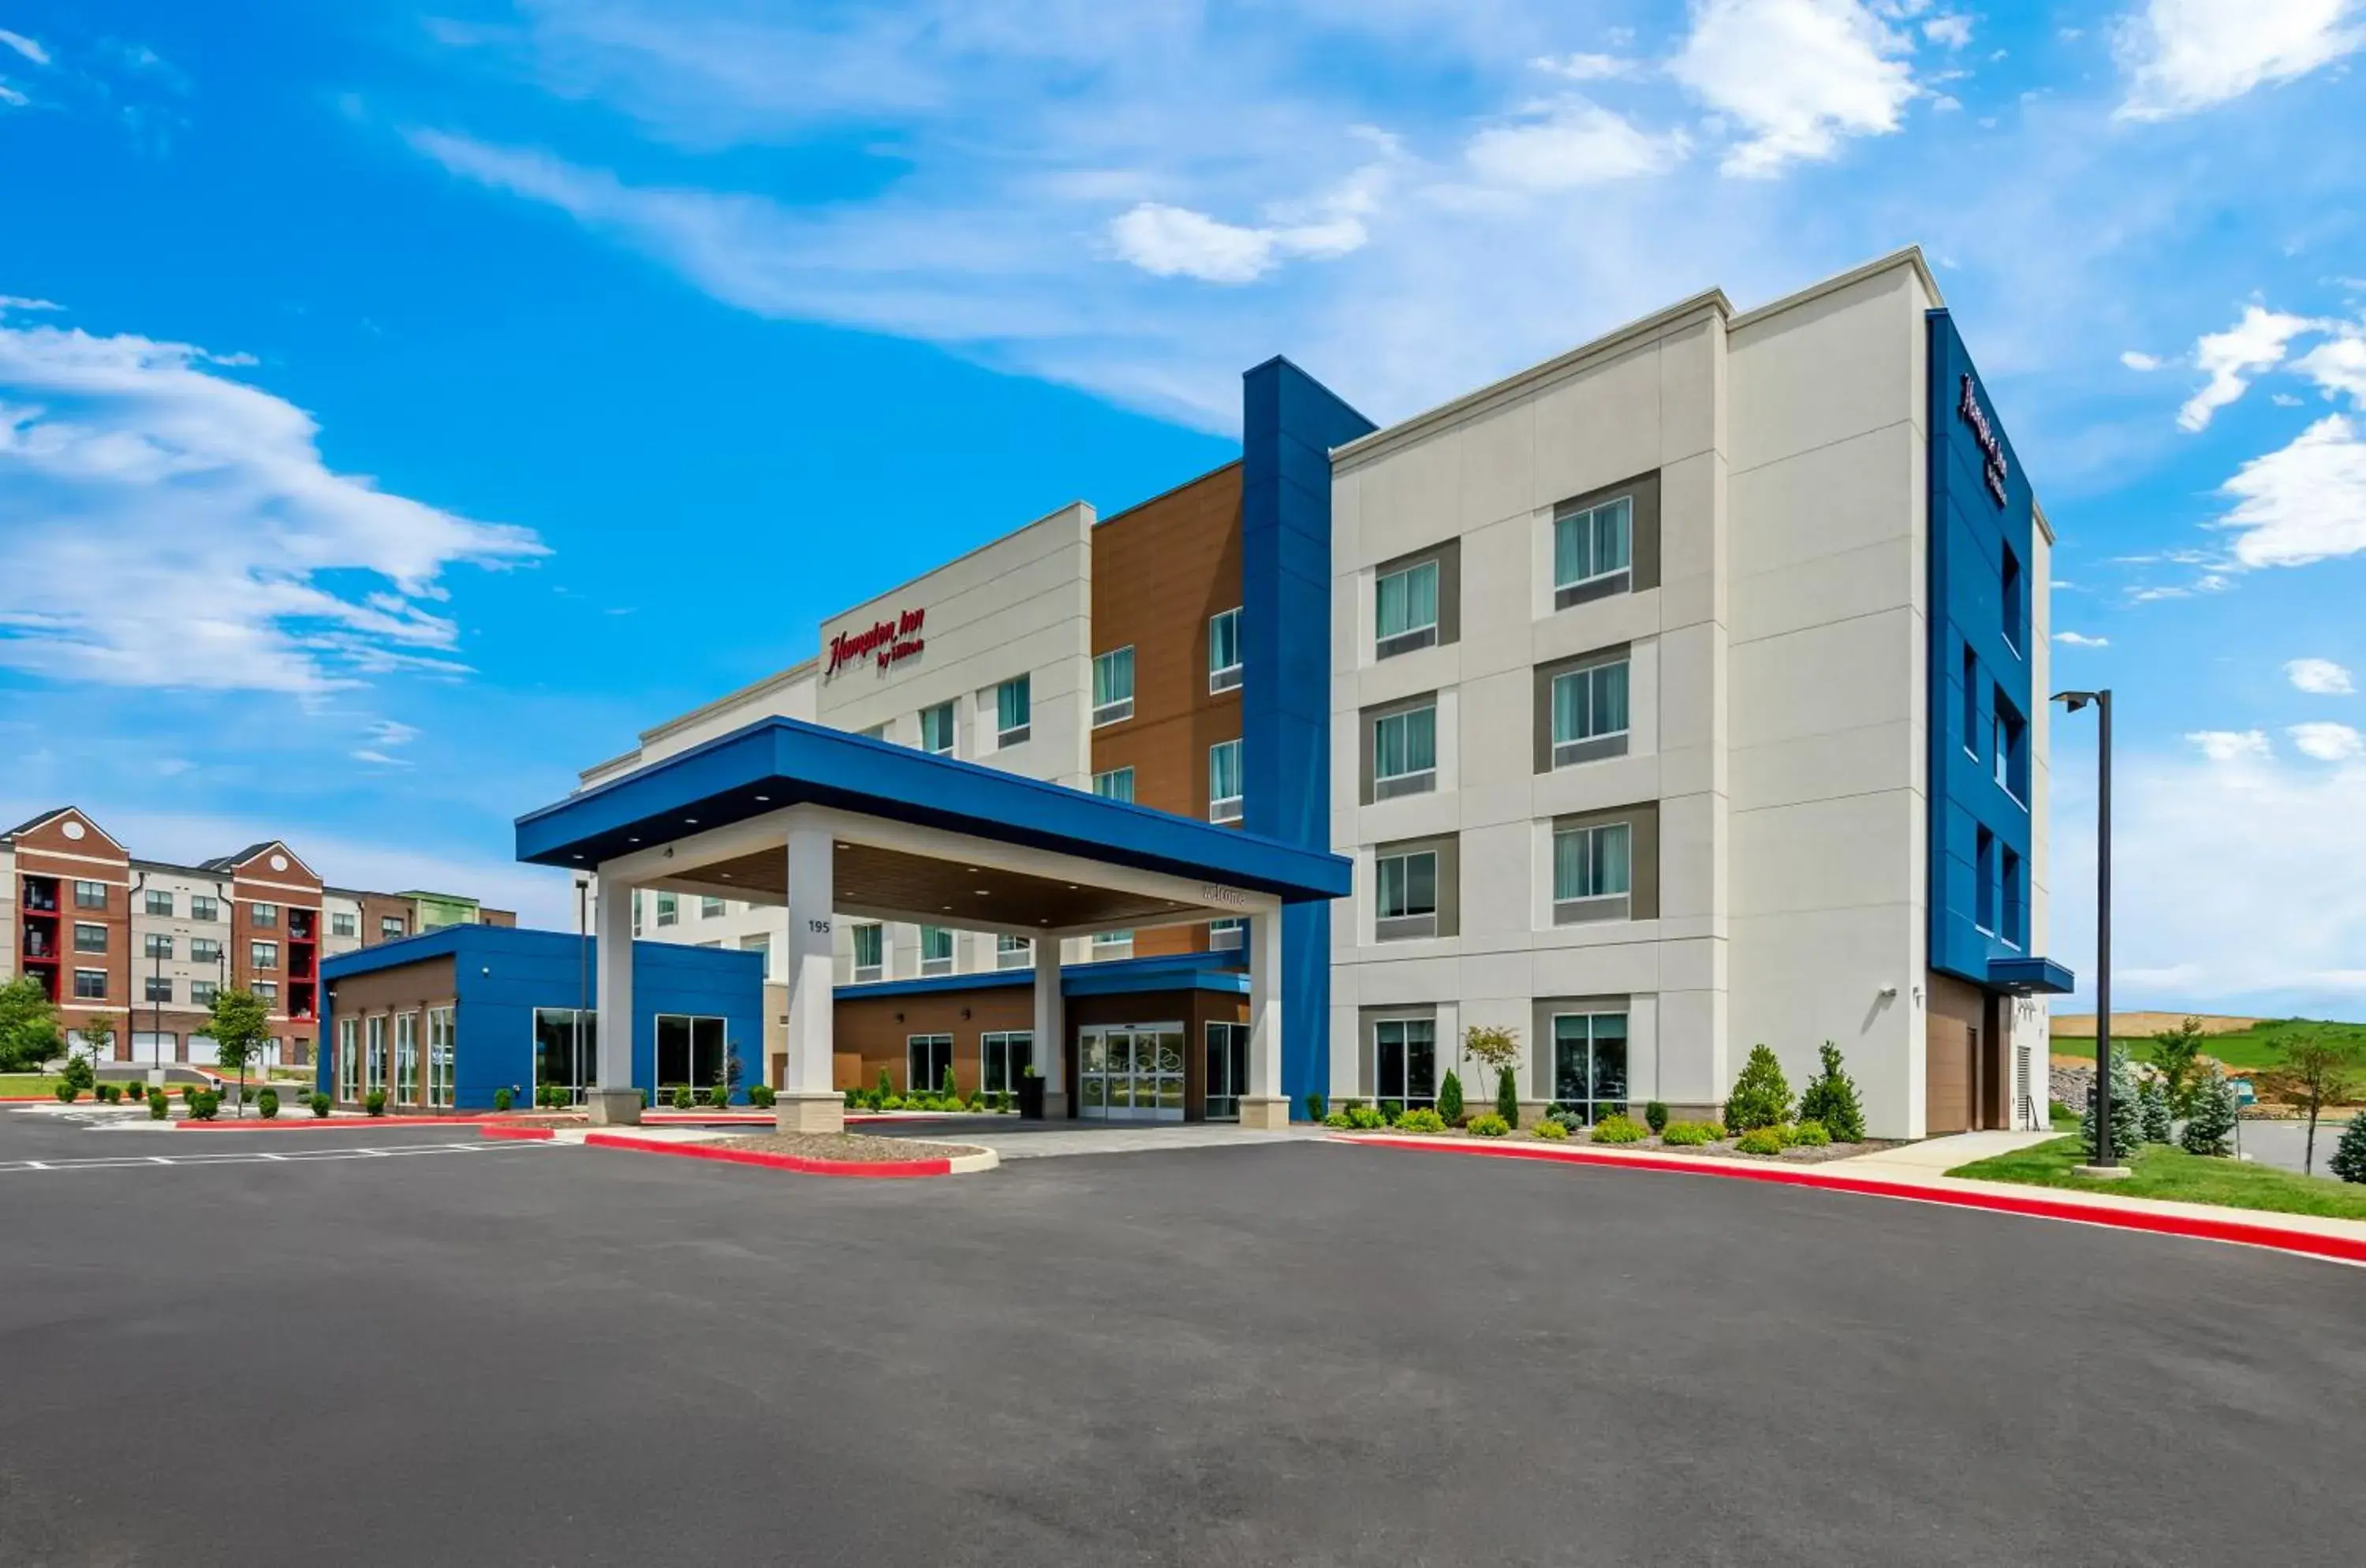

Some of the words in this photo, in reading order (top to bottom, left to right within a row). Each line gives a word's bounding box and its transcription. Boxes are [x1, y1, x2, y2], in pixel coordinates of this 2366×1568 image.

[825, 622, 895, 676] Hampton
[899, 608, 924, 636] Inn
[808, 920, 830, 934] 195
